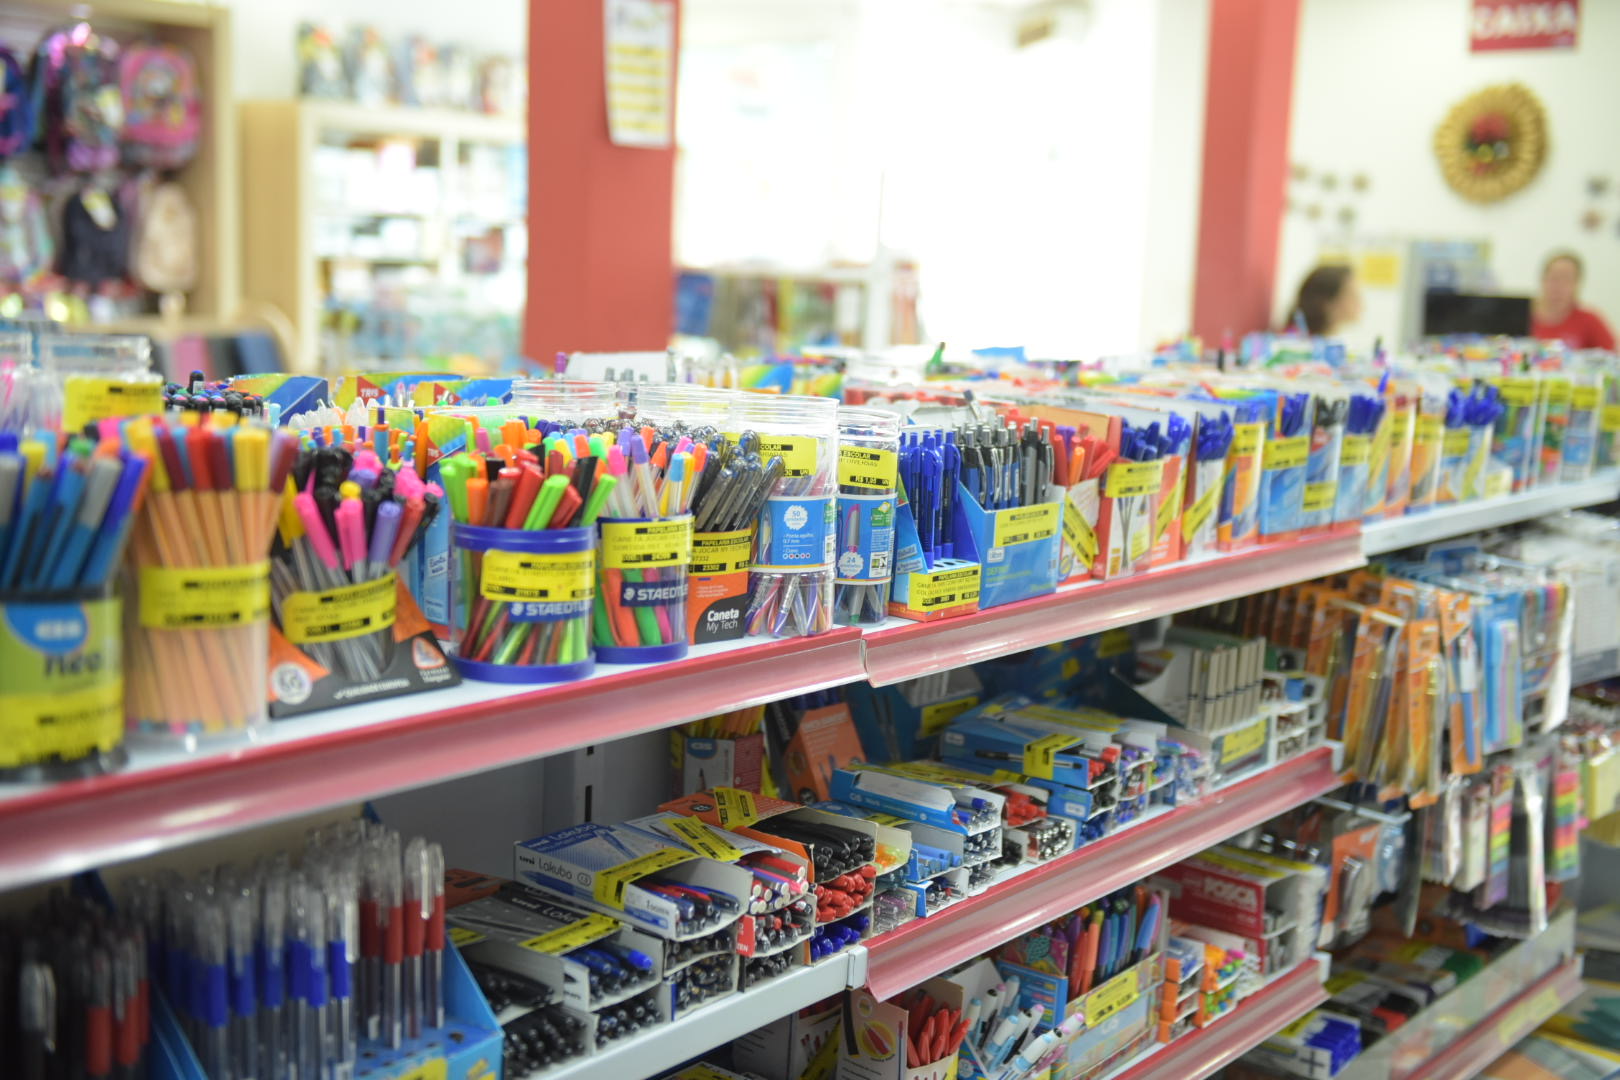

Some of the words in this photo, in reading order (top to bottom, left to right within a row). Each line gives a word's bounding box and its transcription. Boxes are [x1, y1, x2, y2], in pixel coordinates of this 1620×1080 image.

[707, 608, 740, 622] Caneta
[706, 622, 719, 634] My
[721, 619, 738, 630] Tech
[538, 857, 573, 881] Lakubo
